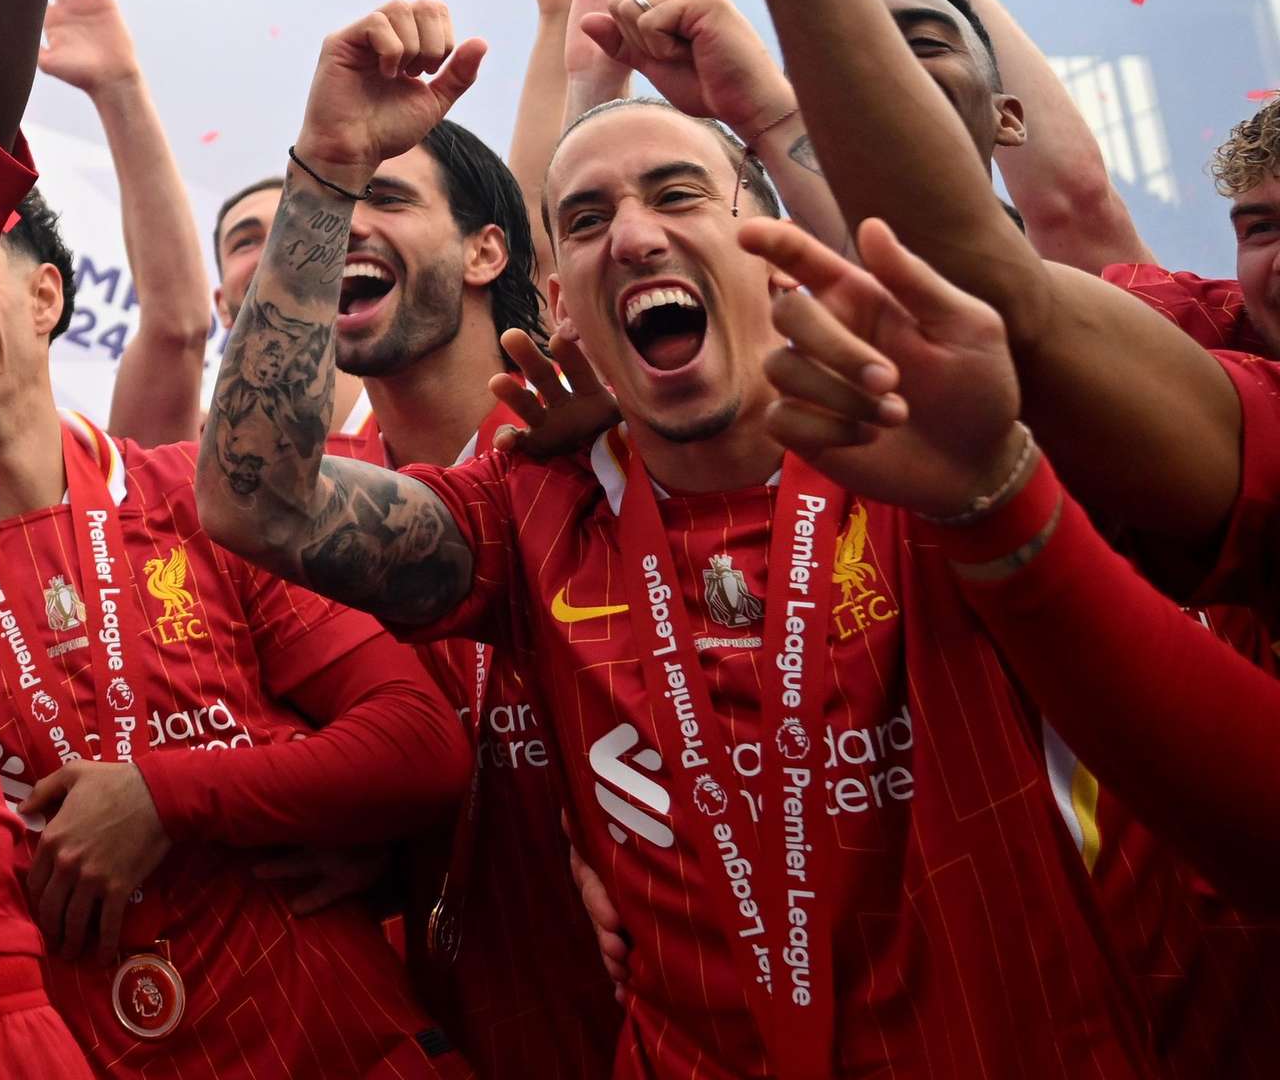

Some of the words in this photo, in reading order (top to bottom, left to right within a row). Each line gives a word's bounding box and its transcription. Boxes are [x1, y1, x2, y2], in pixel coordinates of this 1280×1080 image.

[85, 509, 116, 584] Premier
[789, 493, 828, 595] Premier
[98, 587, 124, 671] League
[642, 553, 678, 658] League
[775, 600, 816, 708] League
[664, 661, 709, 770] Premier
[783, 767, 813, 882] Premier
[712, 822, 765, 938] League
[782, 888, 816, 1007] League
